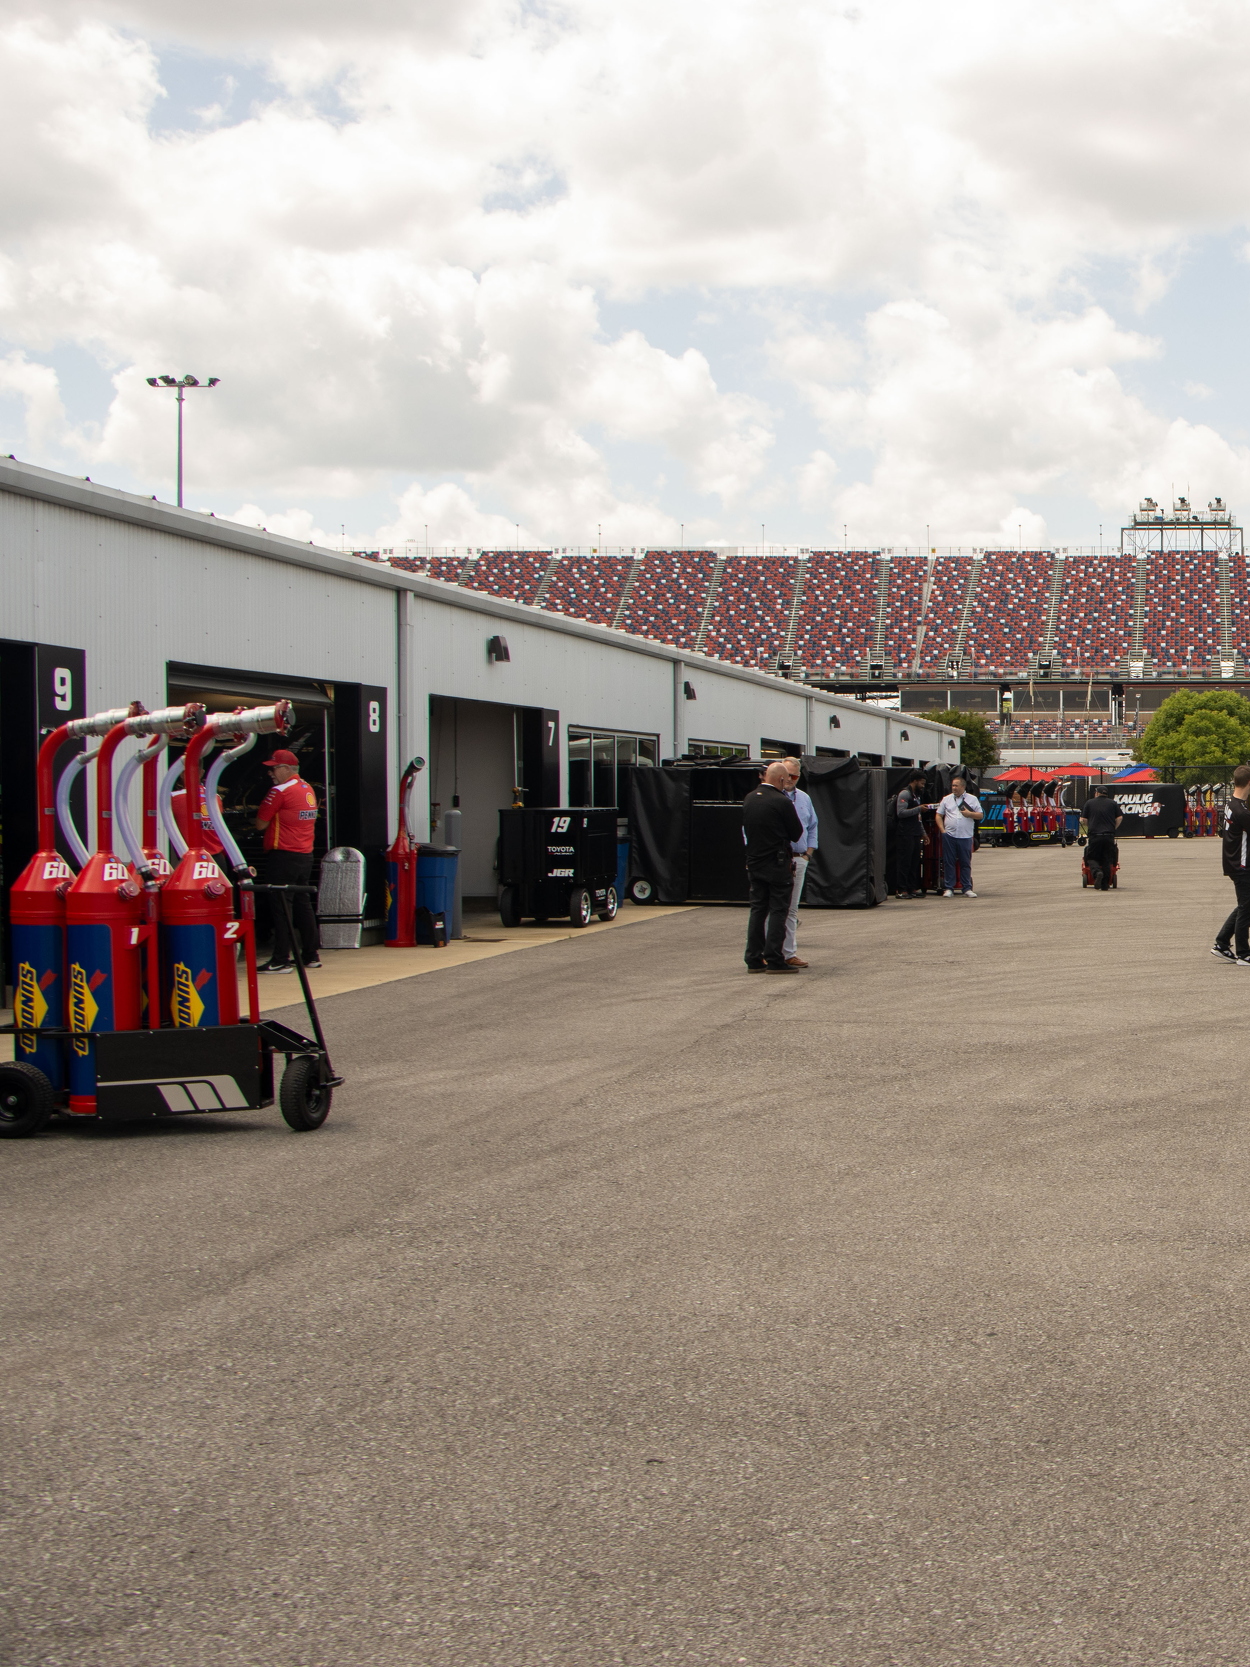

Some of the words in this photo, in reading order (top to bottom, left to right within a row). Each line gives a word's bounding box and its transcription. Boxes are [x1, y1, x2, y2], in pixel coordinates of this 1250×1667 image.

[54, 667, 73, 711] 9
[368, 700, 381, 733] 8
[548, 721, 556, 746] 7
[1113, 792, 1154, 804] KAULIG
[1120, 802, 1153, 814] ACING
[551, 817, 571, 833] 19
[43, 862, 70, 879] 60
[103, 862, 129, 881] 60
[193, 862, 219, 879] 60
[547, 868, 575, 877] JGR
[129, 927, 140, 945] 1
[223, 922, 240, 939] 2
[174, 962, 192, 1028] SUNO
